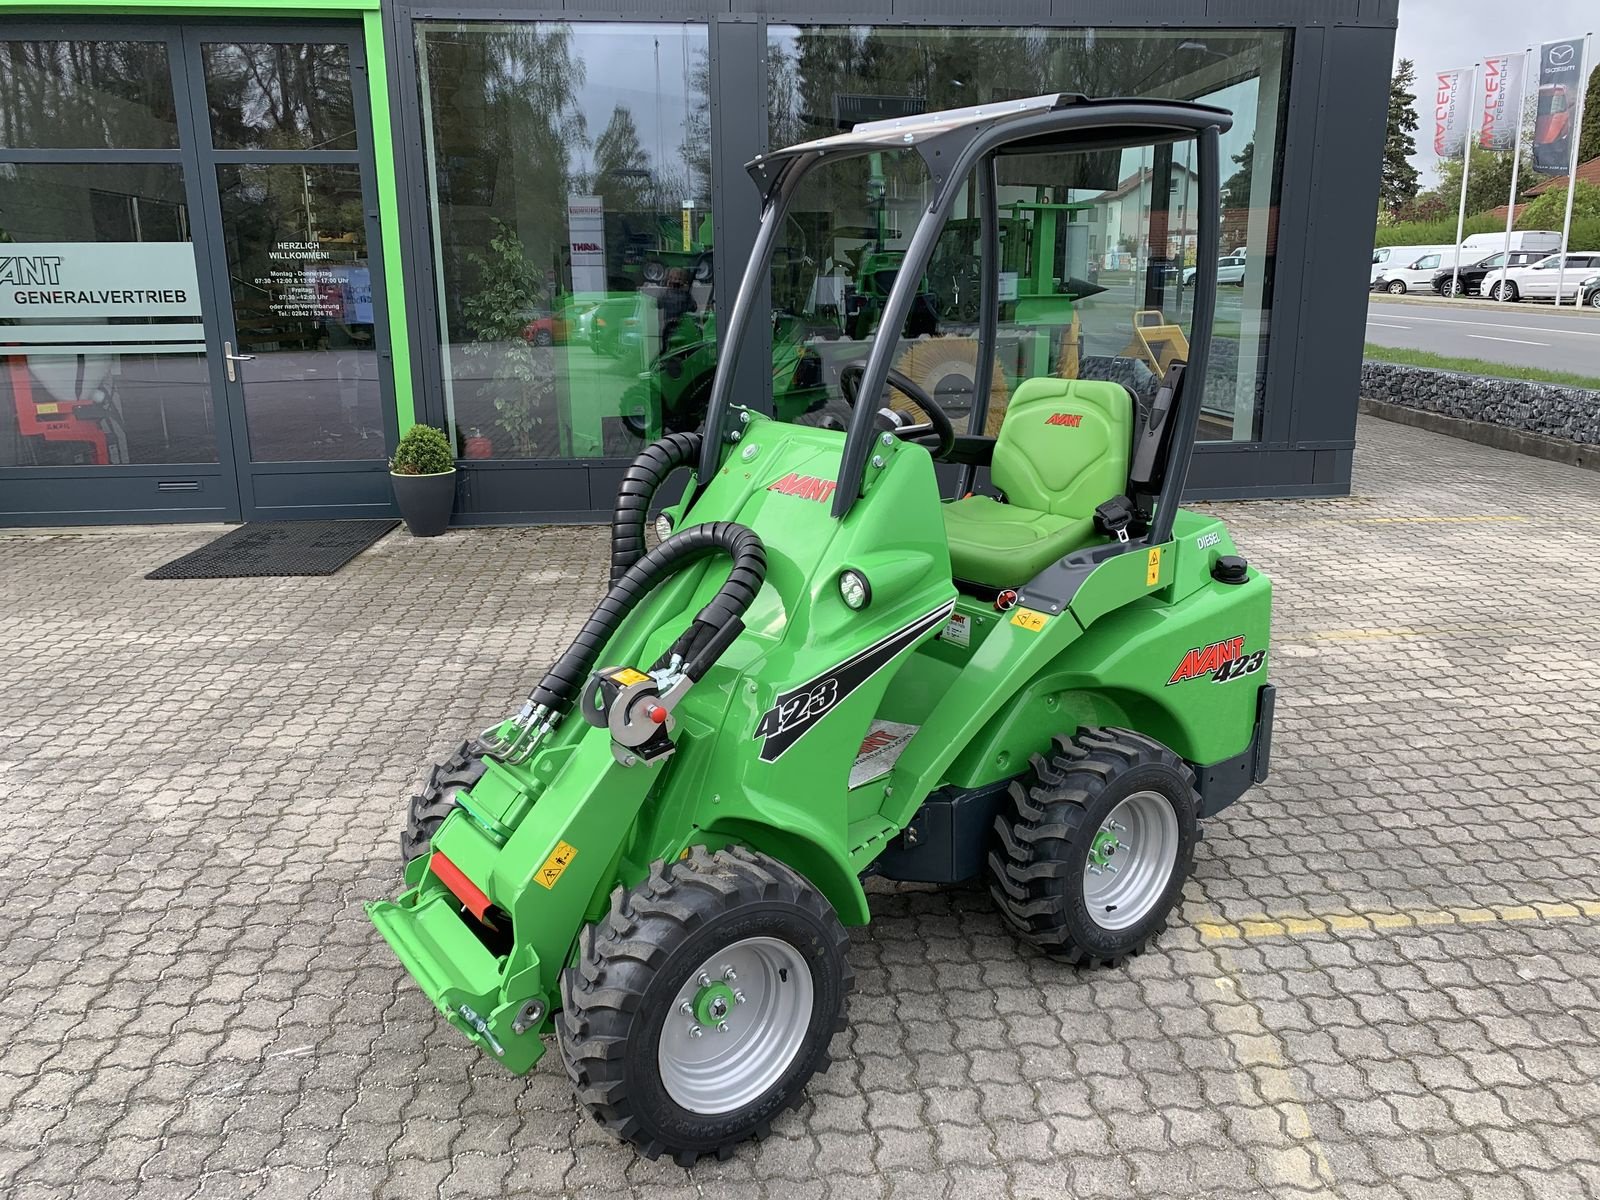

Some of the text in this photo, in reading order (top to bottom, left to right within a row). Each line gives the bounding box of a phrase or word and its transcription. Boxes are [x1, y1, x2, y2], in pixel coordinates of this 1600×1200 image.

[277, 242, 320, 250] HERZLICH
[269, 252, 330, 260] WILLKOMMEN!
[297, 270, 333, 278] Donnerstag
[14, 289, 187, 305] GENERALVERTRIEB
[1044, 413, 1083, 428] AVANT
[766, 472, 837, 505] AVANT
[1196, 531, 1221, 549] DIESEL
[1165, 634, 1245, 686] AVANT
[1211, 650, 1266, 684] 423
[752, 678, 839, 740] 423
